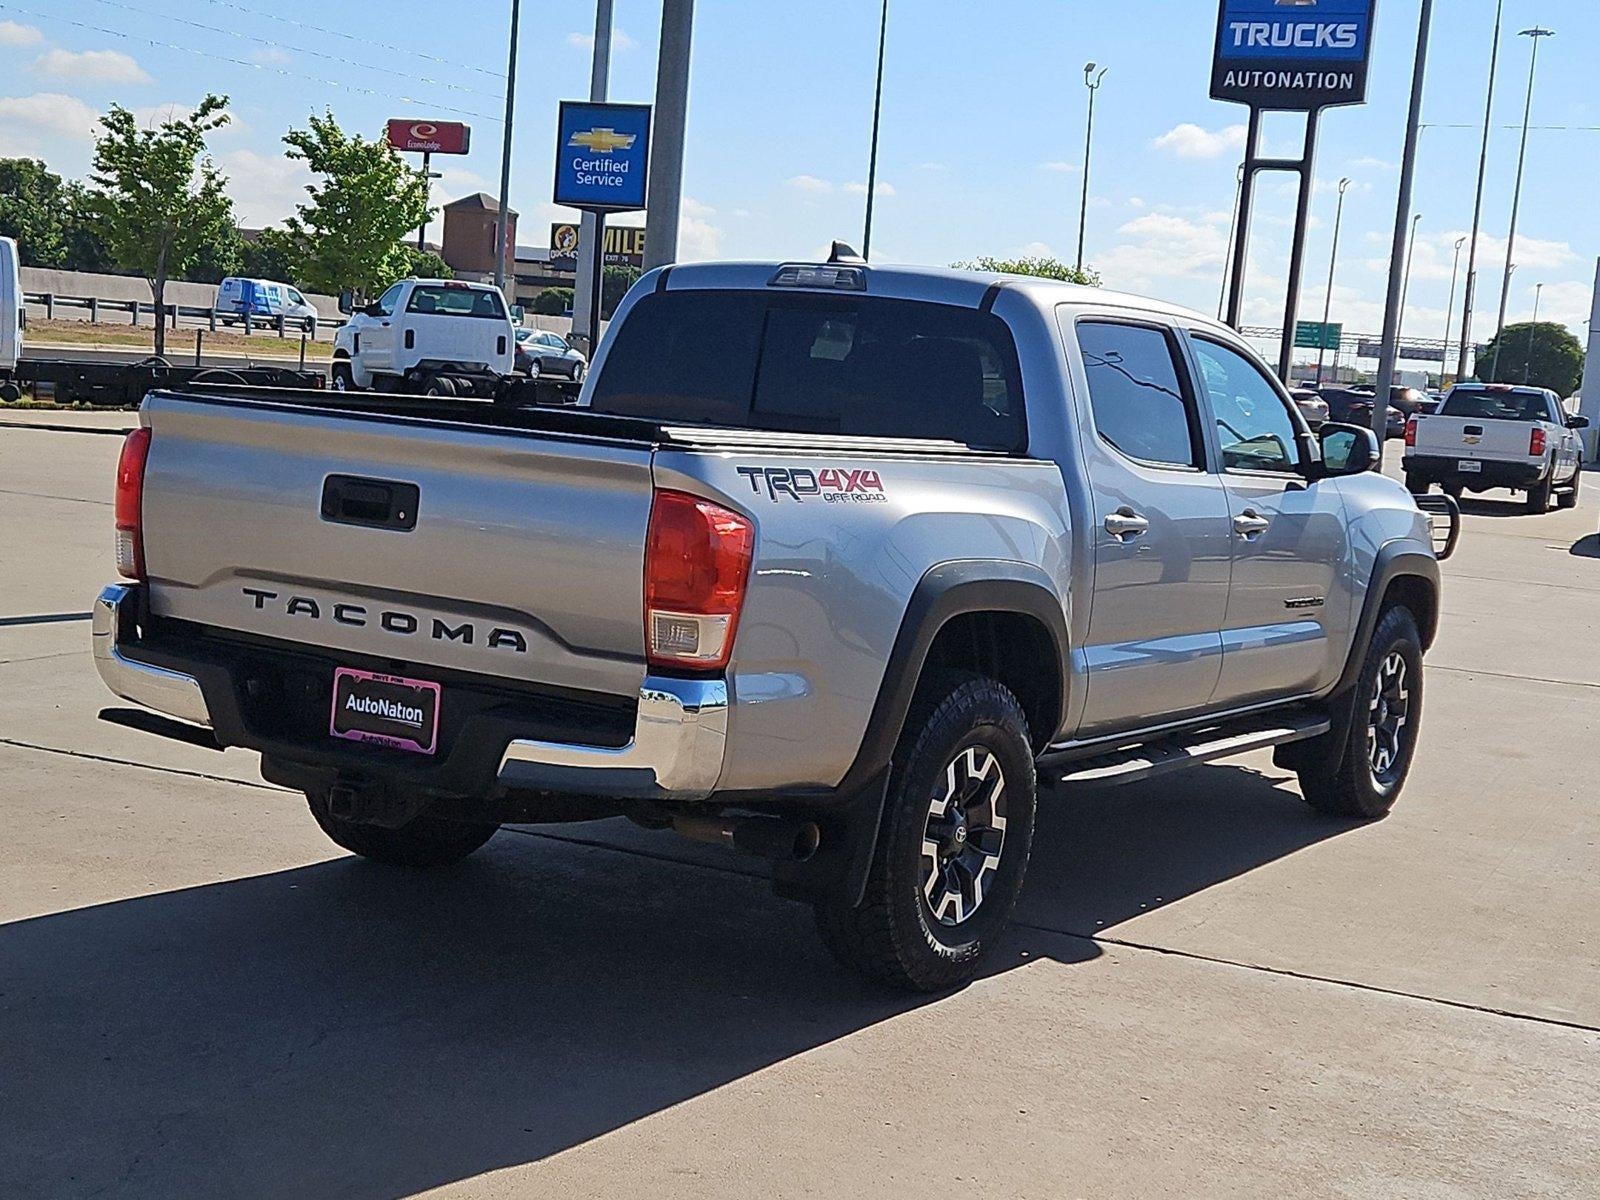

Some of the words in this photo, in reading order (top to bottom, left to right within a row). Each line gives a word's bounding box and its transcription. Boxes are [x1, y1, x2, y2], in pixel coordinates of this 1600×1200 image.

[1230, 23, 1357, 47] TRUCKS
[1224, 71, 1353, 89] AUTONATION
[572, 157, 629, 173] Certified
[576, 171, 624, 187] Service
[736, 466, 821, 503] TRD
[823, 492, 848, 503] OFF
[851, 492, 887, 504] ROAD
[243, 588, 527, 652] TACOMA
[345, 693, 424, 722] AutoNation
